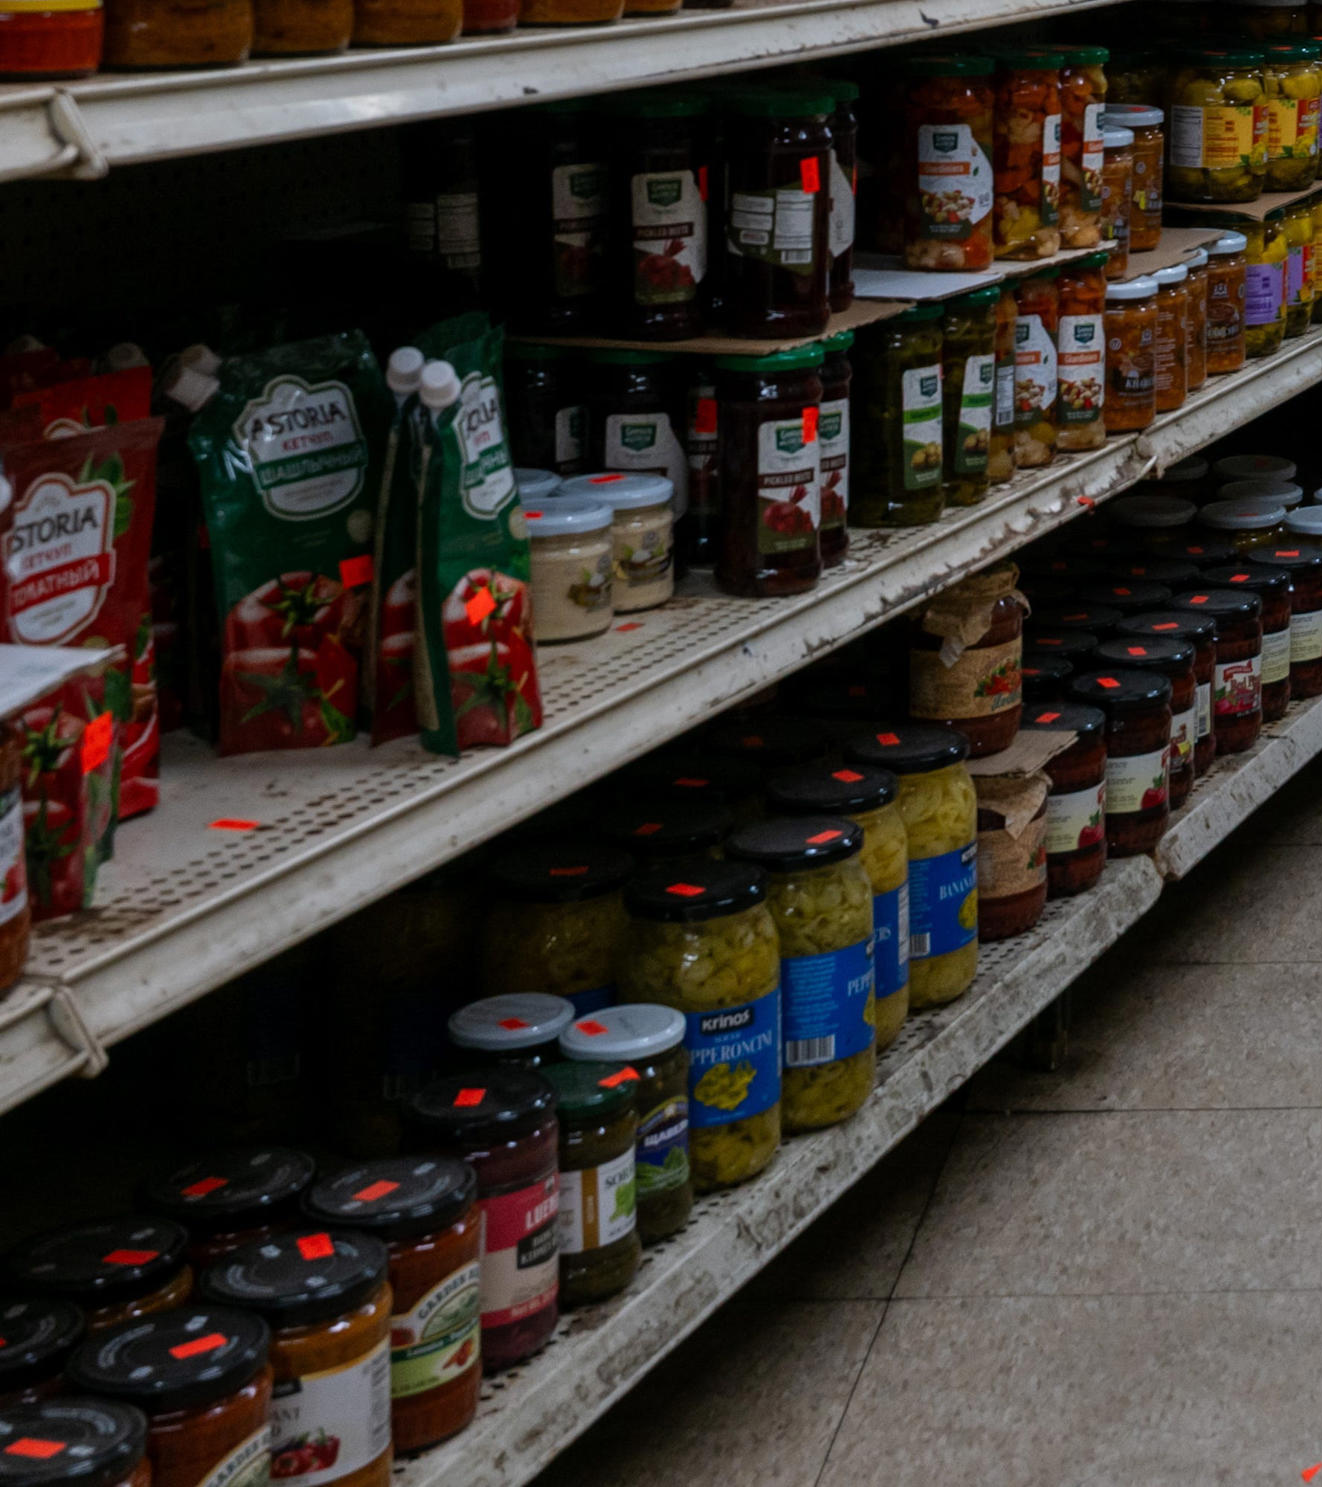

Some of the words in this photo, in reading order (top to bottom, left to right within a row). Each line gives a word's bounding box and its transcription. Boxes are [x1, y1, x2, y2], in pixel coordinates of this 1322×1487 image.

[636, 224, 666, 238] PICKLED
[249, 400, 347, 441] ASTORIA
[763, 474, 792, 487] PICKLED
